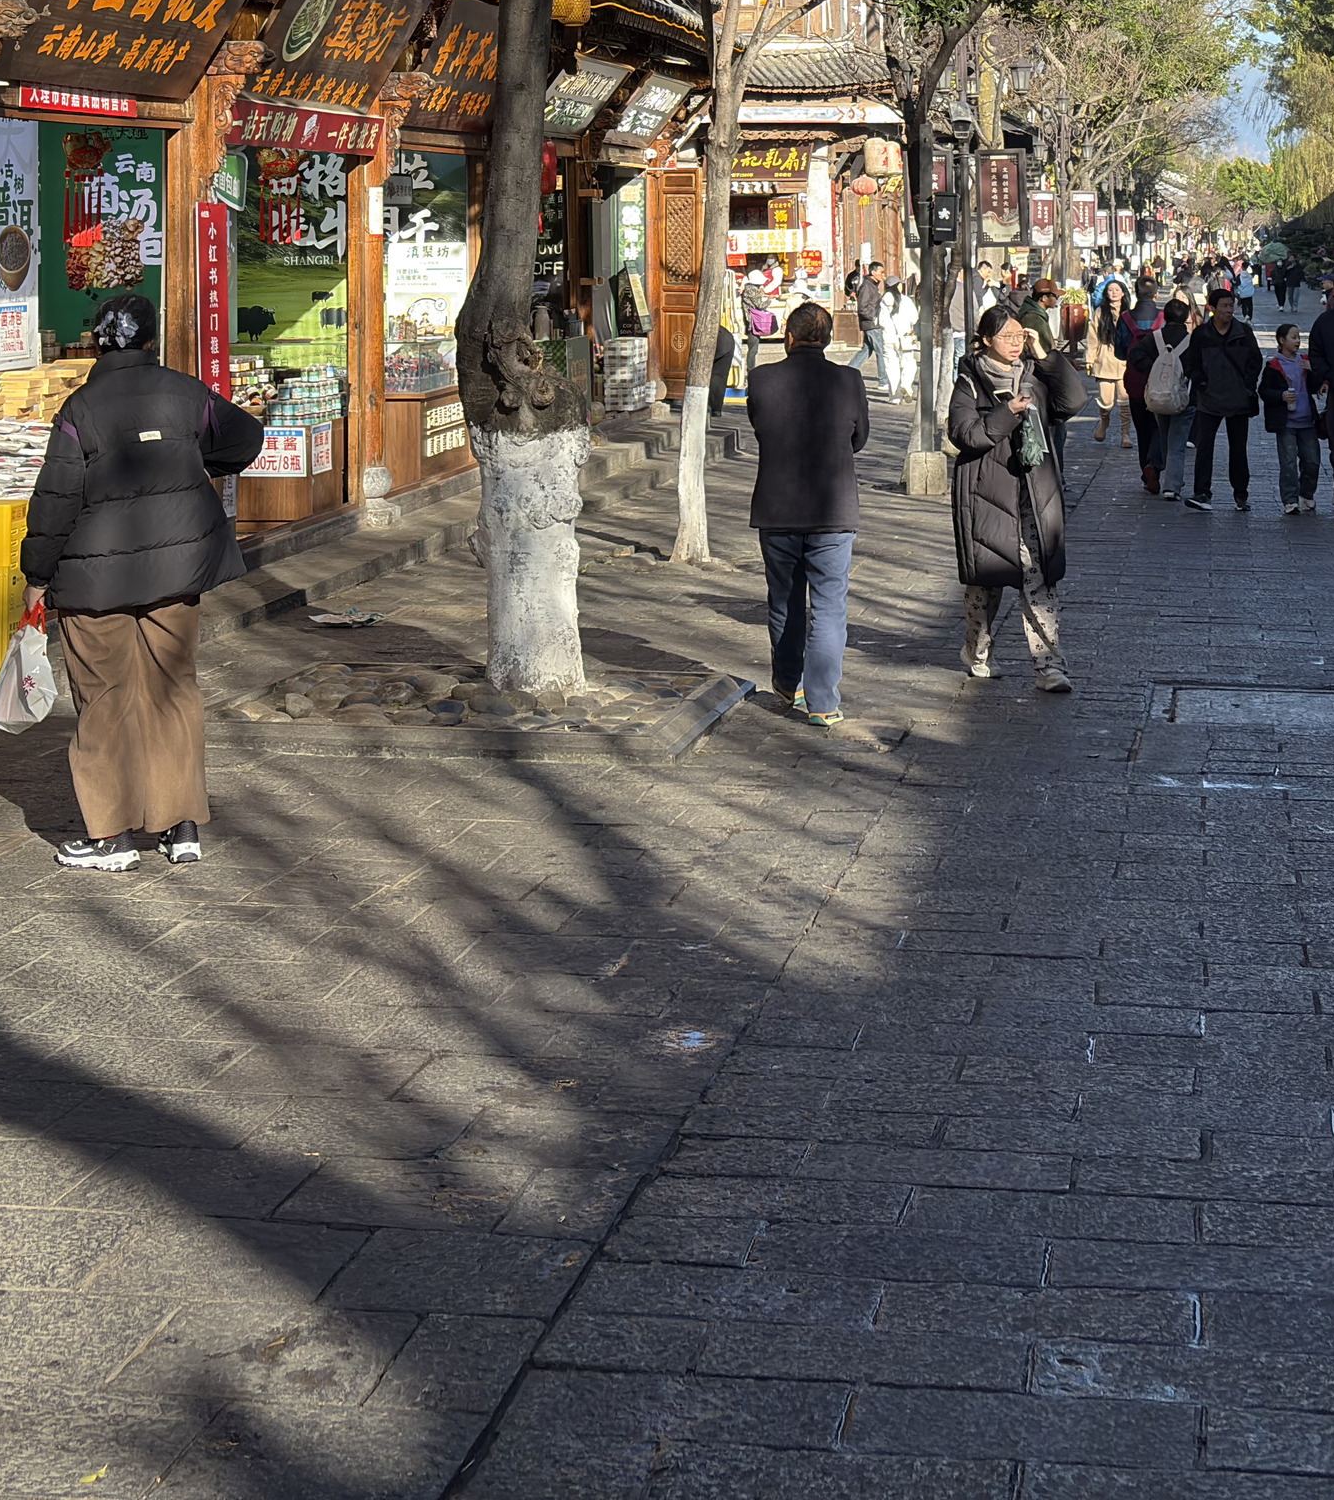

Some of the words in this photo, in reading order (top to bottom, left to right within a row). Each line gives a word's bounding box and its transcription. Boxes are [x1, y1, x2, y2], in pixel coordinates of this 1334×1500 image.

[251, 67, 370, 109] 云南土特产综合批发
[231, 109, 299, 143] 一站式购物
[327, 121, 380, 150] 一件也批发
[115, 152, 156, 183] 云南
[731, 147, 800, 172] 记乳扇
[4, 158, 25, 195] 古树
[406, 245, 450, 259] 滇聚坊
